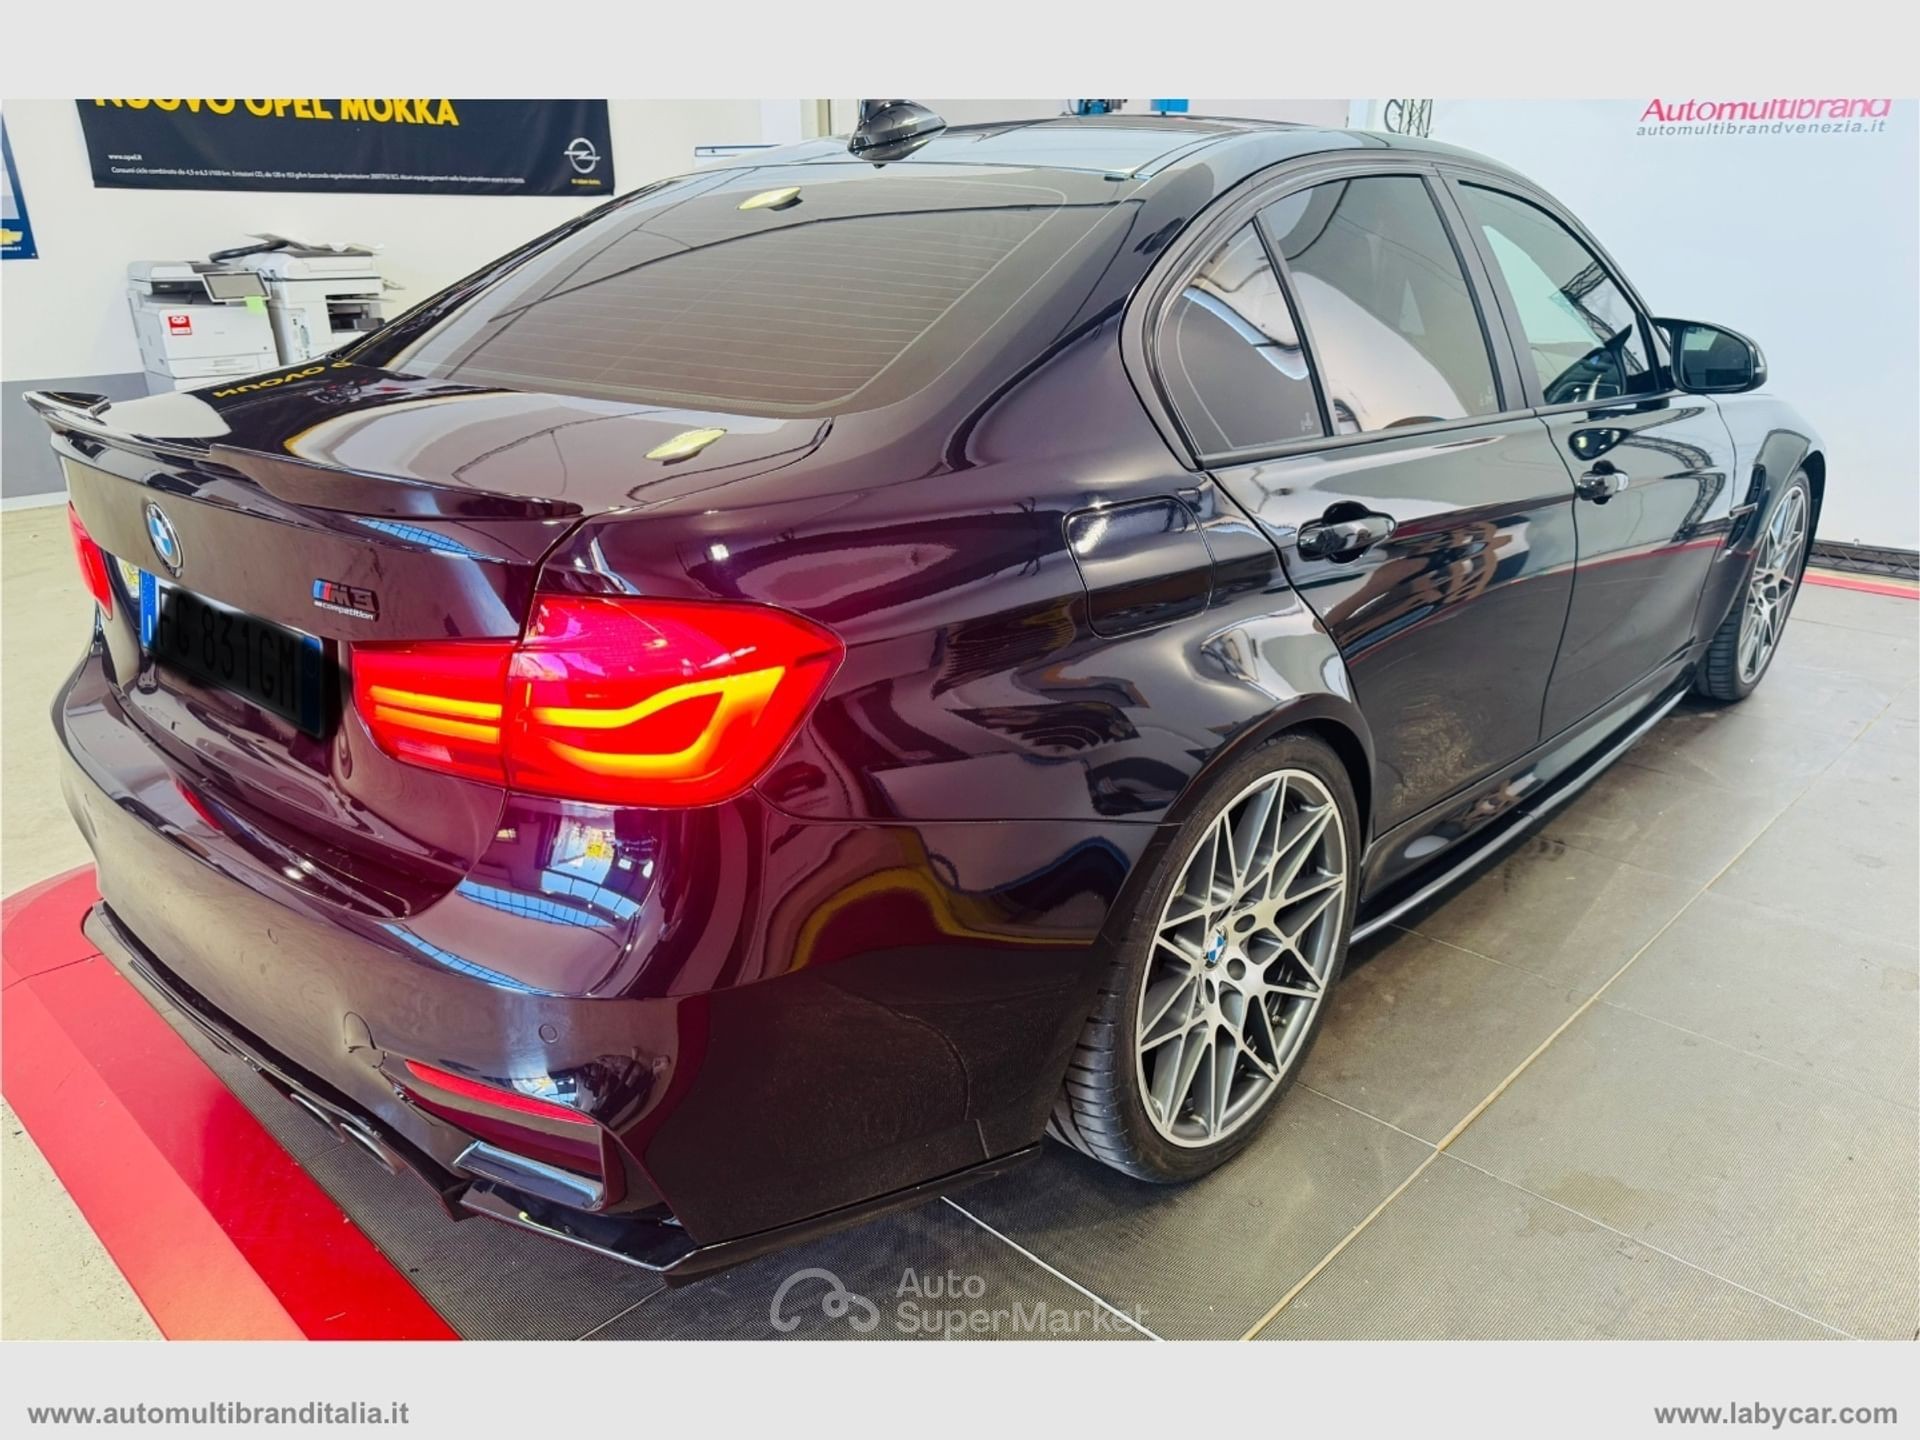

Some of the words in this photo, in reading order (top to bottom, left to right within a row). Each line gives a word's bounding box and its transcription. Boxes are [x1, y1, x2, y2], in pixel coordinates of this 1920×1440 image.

[243, 98, 334, 120] OPEL
[341, 98, 460, 126] MOKKA
[1636, 120, 1887, 137] automultibrandvenezia.it
